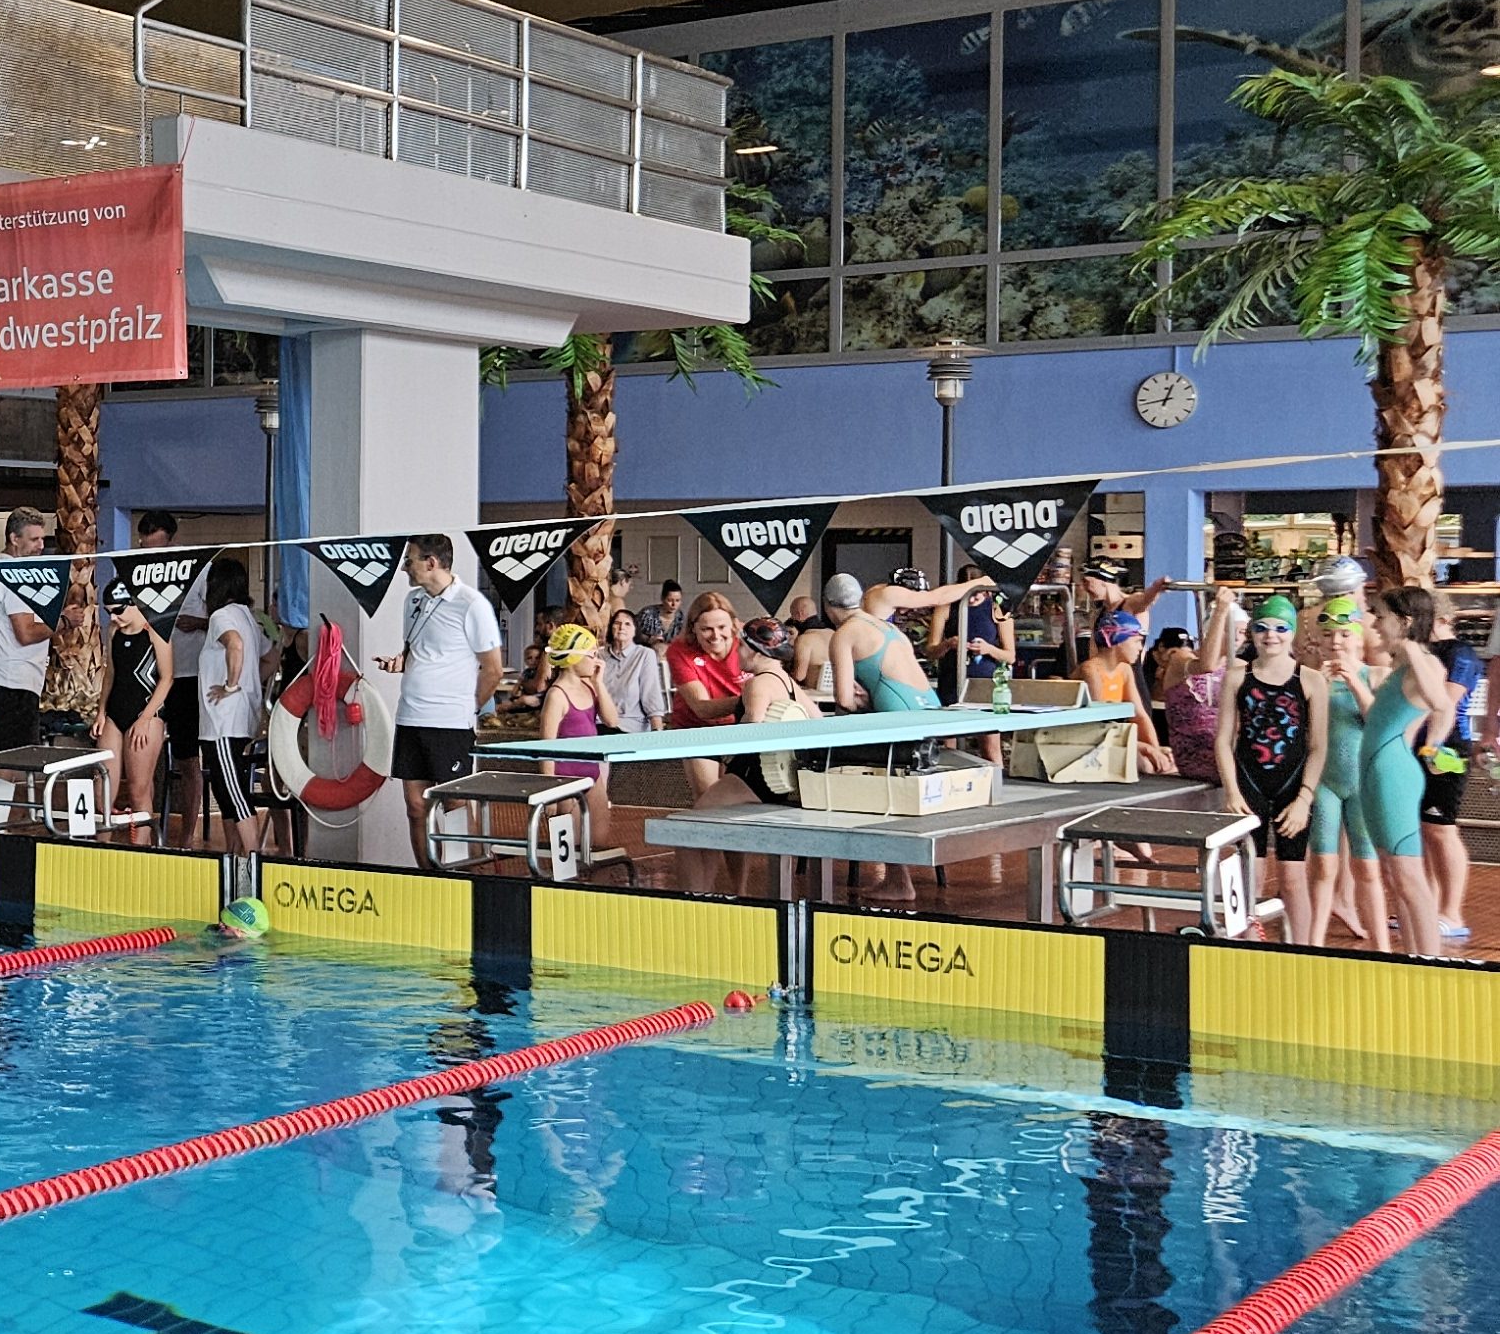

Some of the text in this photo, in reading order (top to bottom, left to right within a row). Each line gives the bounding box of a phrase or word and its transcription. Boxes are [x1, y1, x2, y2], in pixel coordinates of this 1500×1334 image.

[93, 204, 126, 220] von
[960, 500, 1058, 534] arena
[488, 528, 567, 557] arena
[721, 518, 807, 548] arena
[319, 542, 392, 560] arena
[0, 568, 60, 584] arena
[132, 559, 192, 586] arena
[74, 793, 89, 821] 4
[558, 829, 570, 863] 5
[273, 881, 380, 917] OMEGA
[1230, 875, 1238, 915] 6
[829, 934, 975, 977] OMEGA
